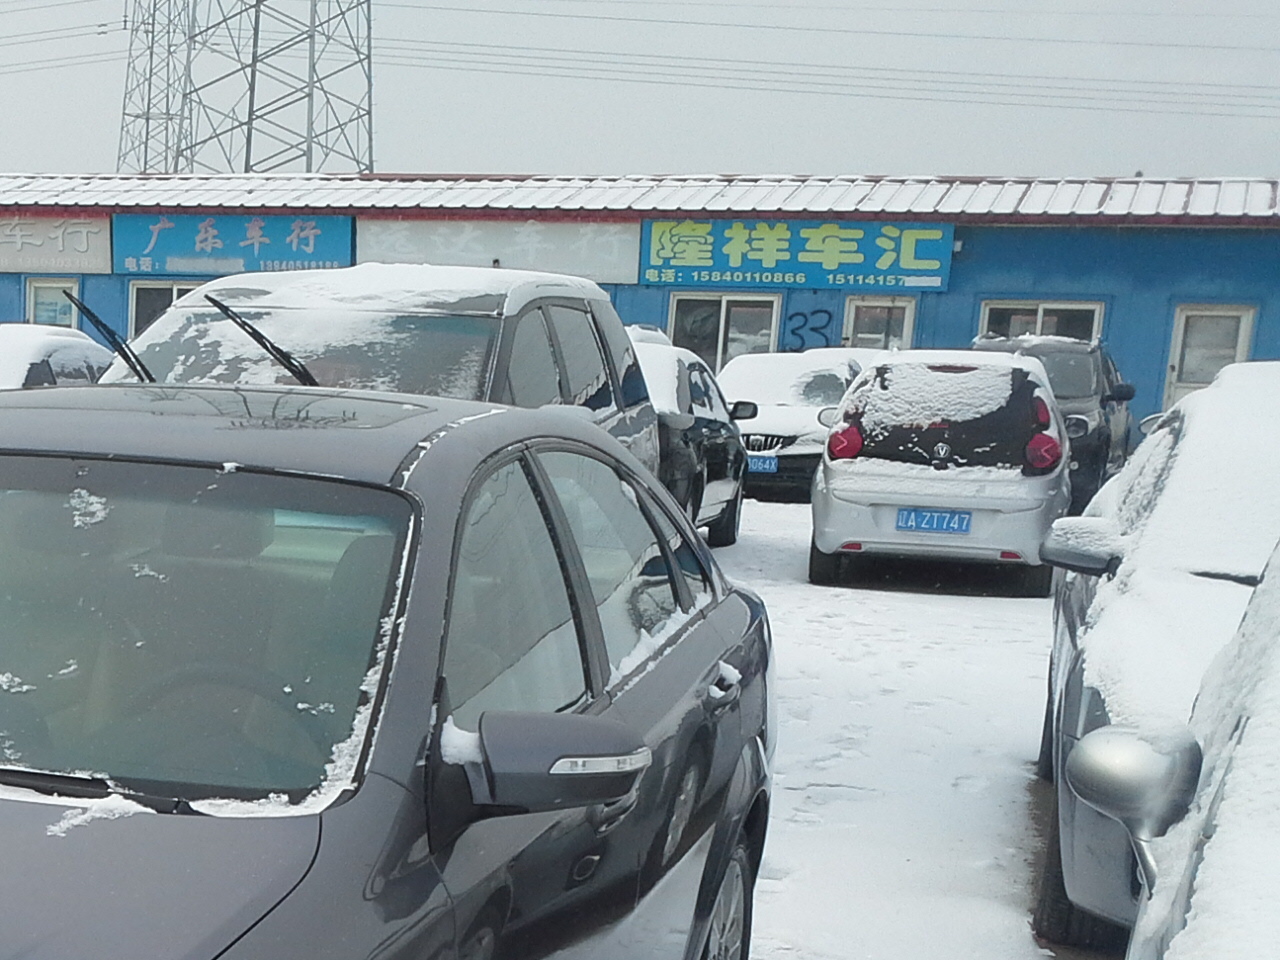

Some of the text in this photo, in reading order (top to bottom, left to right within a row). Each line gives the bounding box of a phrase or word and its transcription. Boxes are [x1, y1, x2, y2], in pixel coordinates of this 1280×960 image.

[650, 219, 943, 270] 隆祥车汇
[691, 271, 807, 284] 15840110866
